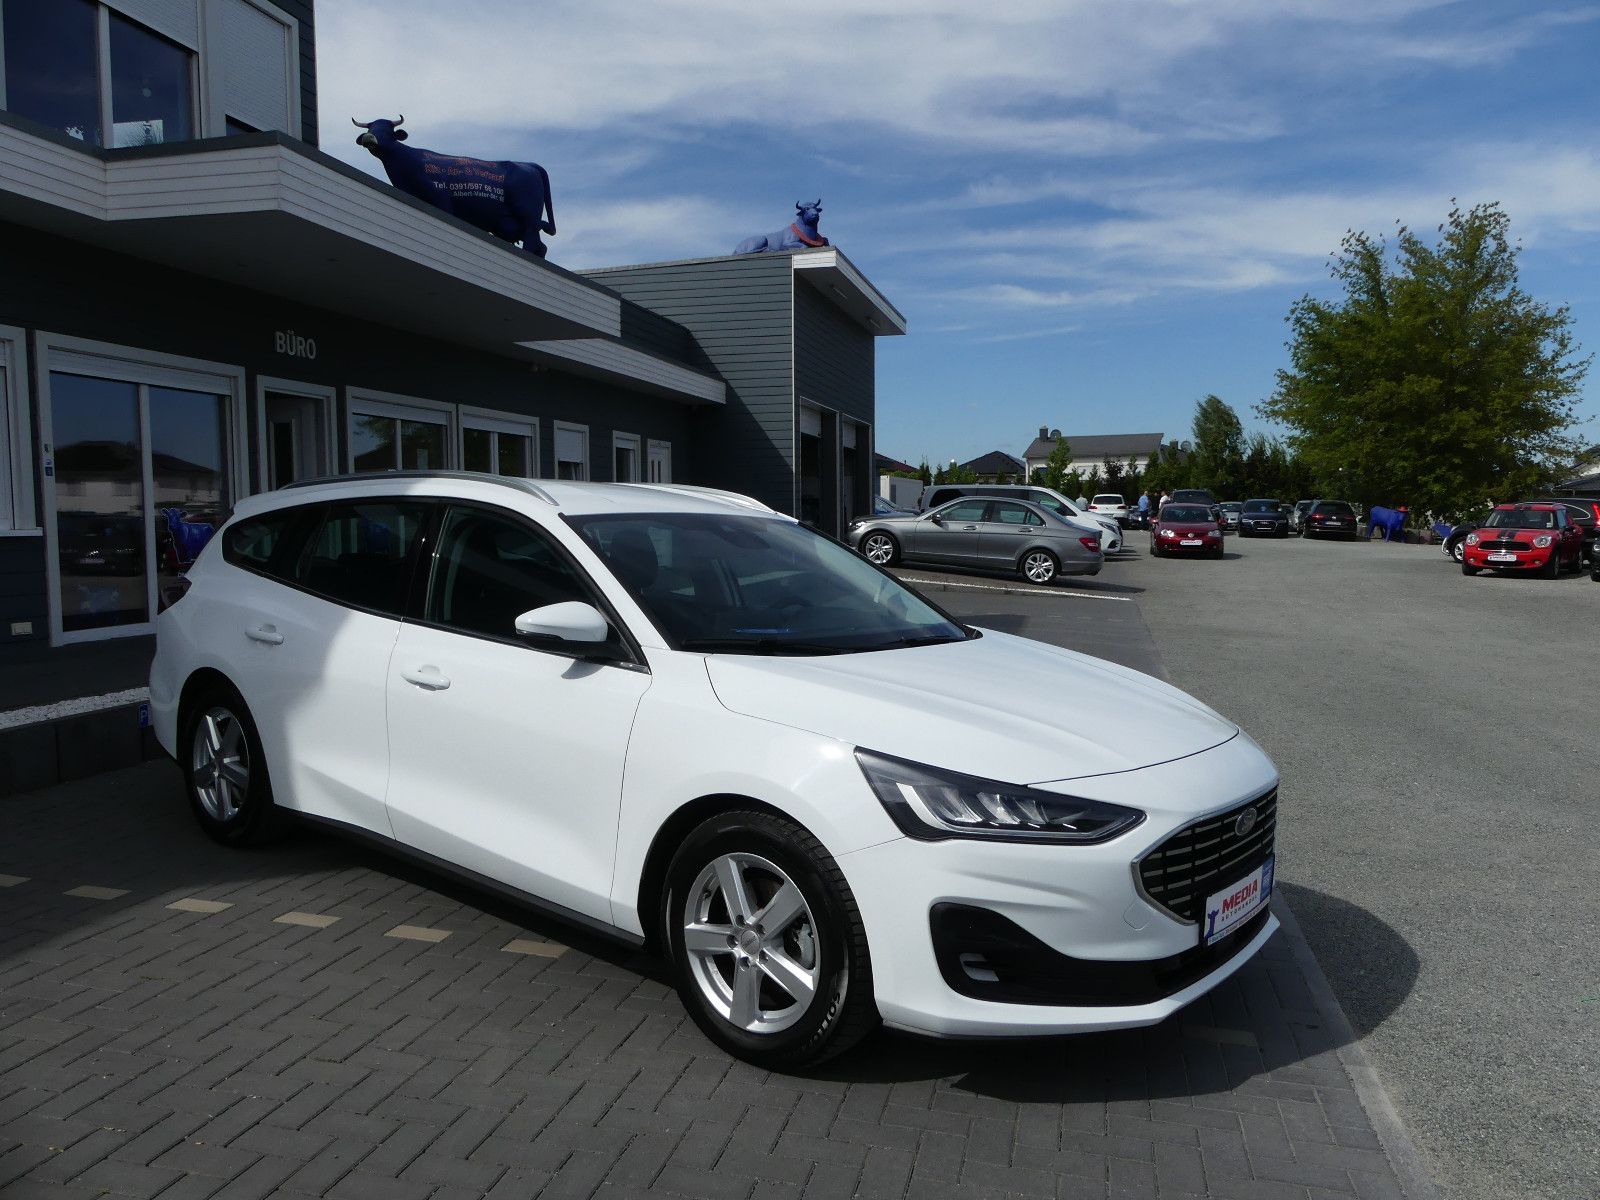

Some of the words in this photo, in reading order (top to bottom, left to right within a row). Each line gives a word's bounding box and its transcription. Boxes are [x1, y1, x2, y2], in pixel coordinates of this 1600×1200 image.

[433, 181, 448, 190] Tel.
[449, 182, 482, 191] 0391/597
[276, 330, 317, 360] BÜRO
[1222, 879, 1258, 914] MEDIA
